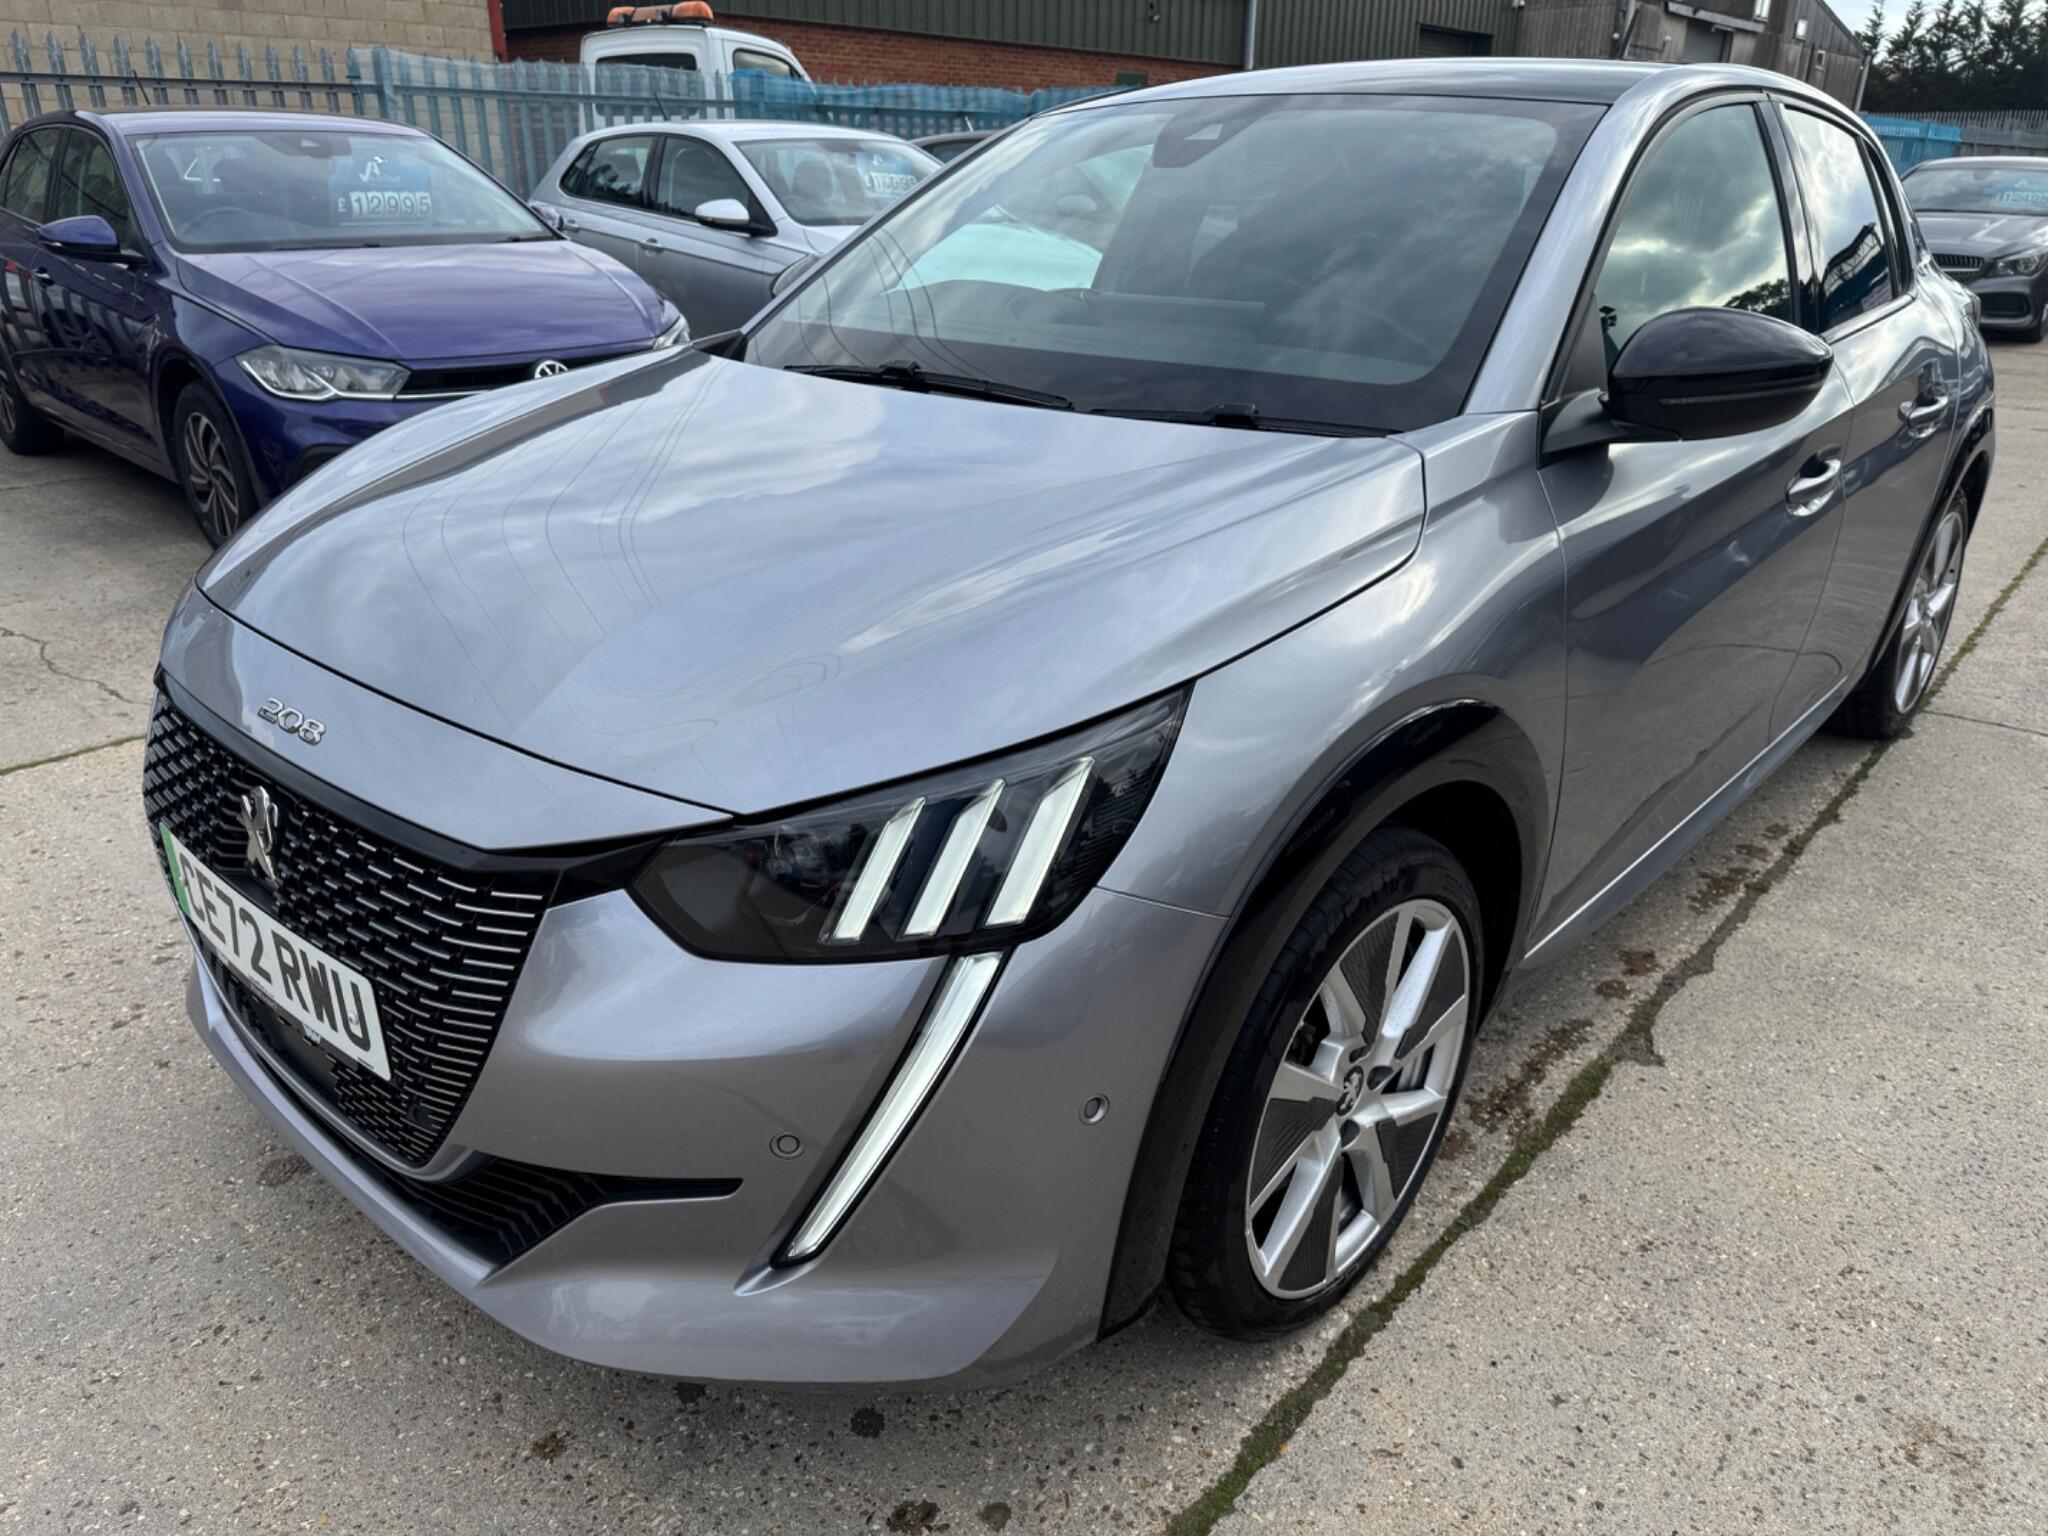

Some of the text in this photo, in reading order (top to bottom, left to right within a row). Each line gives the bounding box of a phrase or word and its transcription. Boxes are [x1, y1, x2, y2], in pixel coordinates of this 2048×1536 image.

[257, 697, 326, 746] 208
[179, 852, 371, 1053] CE72 RWU
